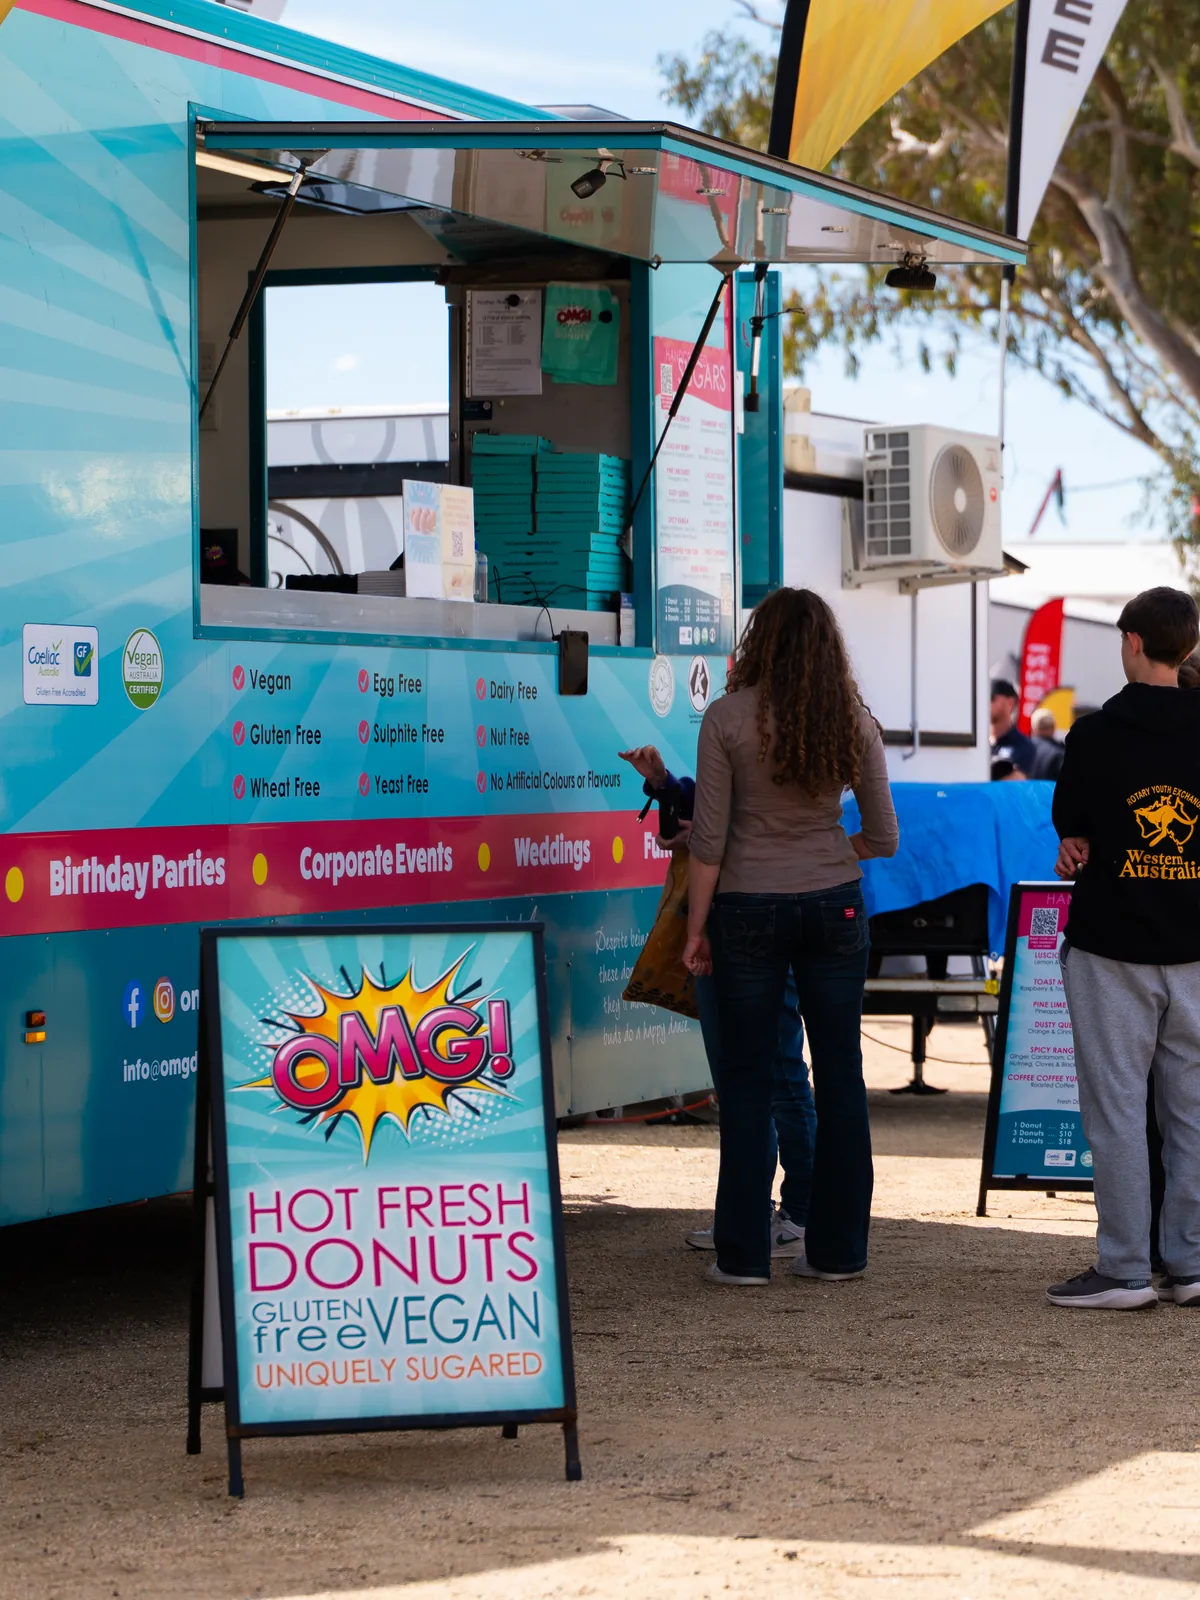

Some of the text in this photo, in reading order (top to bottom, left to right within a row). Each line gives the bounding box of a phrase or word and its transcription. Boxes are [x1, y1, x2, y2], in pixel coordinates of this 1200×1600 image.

[678, 356, 726, 393] SGARS
[28, 646, 61, 665] Coeliac
[76, 645, 88, 658] GF
[127, 637, 158, 671] Vegan
[129, 671, 158, 680] AUSTRALIA
[250, 669, 291, 695] Vegan
[373, 673, 422, 697] Egg Free
[36, 686, 87, 697] Gluten Free Accredited
[129, 685, 158, 695] CERTIFIED
[490, 681, 537, 703] Dairy Free
[250, 724, 322, 745] Gluten Free
[373, 723, 445, 747] Sulphite Free
[490, 728, 529, 745] Nut Free
[250, 776, 320, 798] Wheat Free
[374, 774, 429, 795] Yeast Free
[490, 770, 620, 790] No Artificial Colours or Flavours
[1126, 787, 1151, 806] ROTARY
[1151, 785, 1172, 794] YOUTH
[50, 854, 149, 900] Birthday
[152, 848, 226, 890] Parties
[300, 843, 393, 886] Corporate
[395, 841, 453, 874] Events
[514, 832, 590, 872] Weddings
[1126, 849, 1183, 865] Western
[595, 926, 628, 958] Despite
[599, 964, 618, 983] these
[1033, 978, 1056, 986] TOAST
[603, 1016, 691, 1046] buds do a happy dance.
[271, 999, 516, 1110] OMG!
[1019, 1129, 1044, 1137] Donuts
[1060, 1122, 1075, 1130] $3.5
[249, 1182, 530, 1234] HOT FRESH
[249, 1231, 538, 1293] DONUTS
[252, 1298, 363, 1324] GLUTEN
[367, 1290, 541, 1346] VEGAN
[253, 1322, 367, 1354] free
[256, 1352, 543, 1389] UNIQUELY SUGARED
